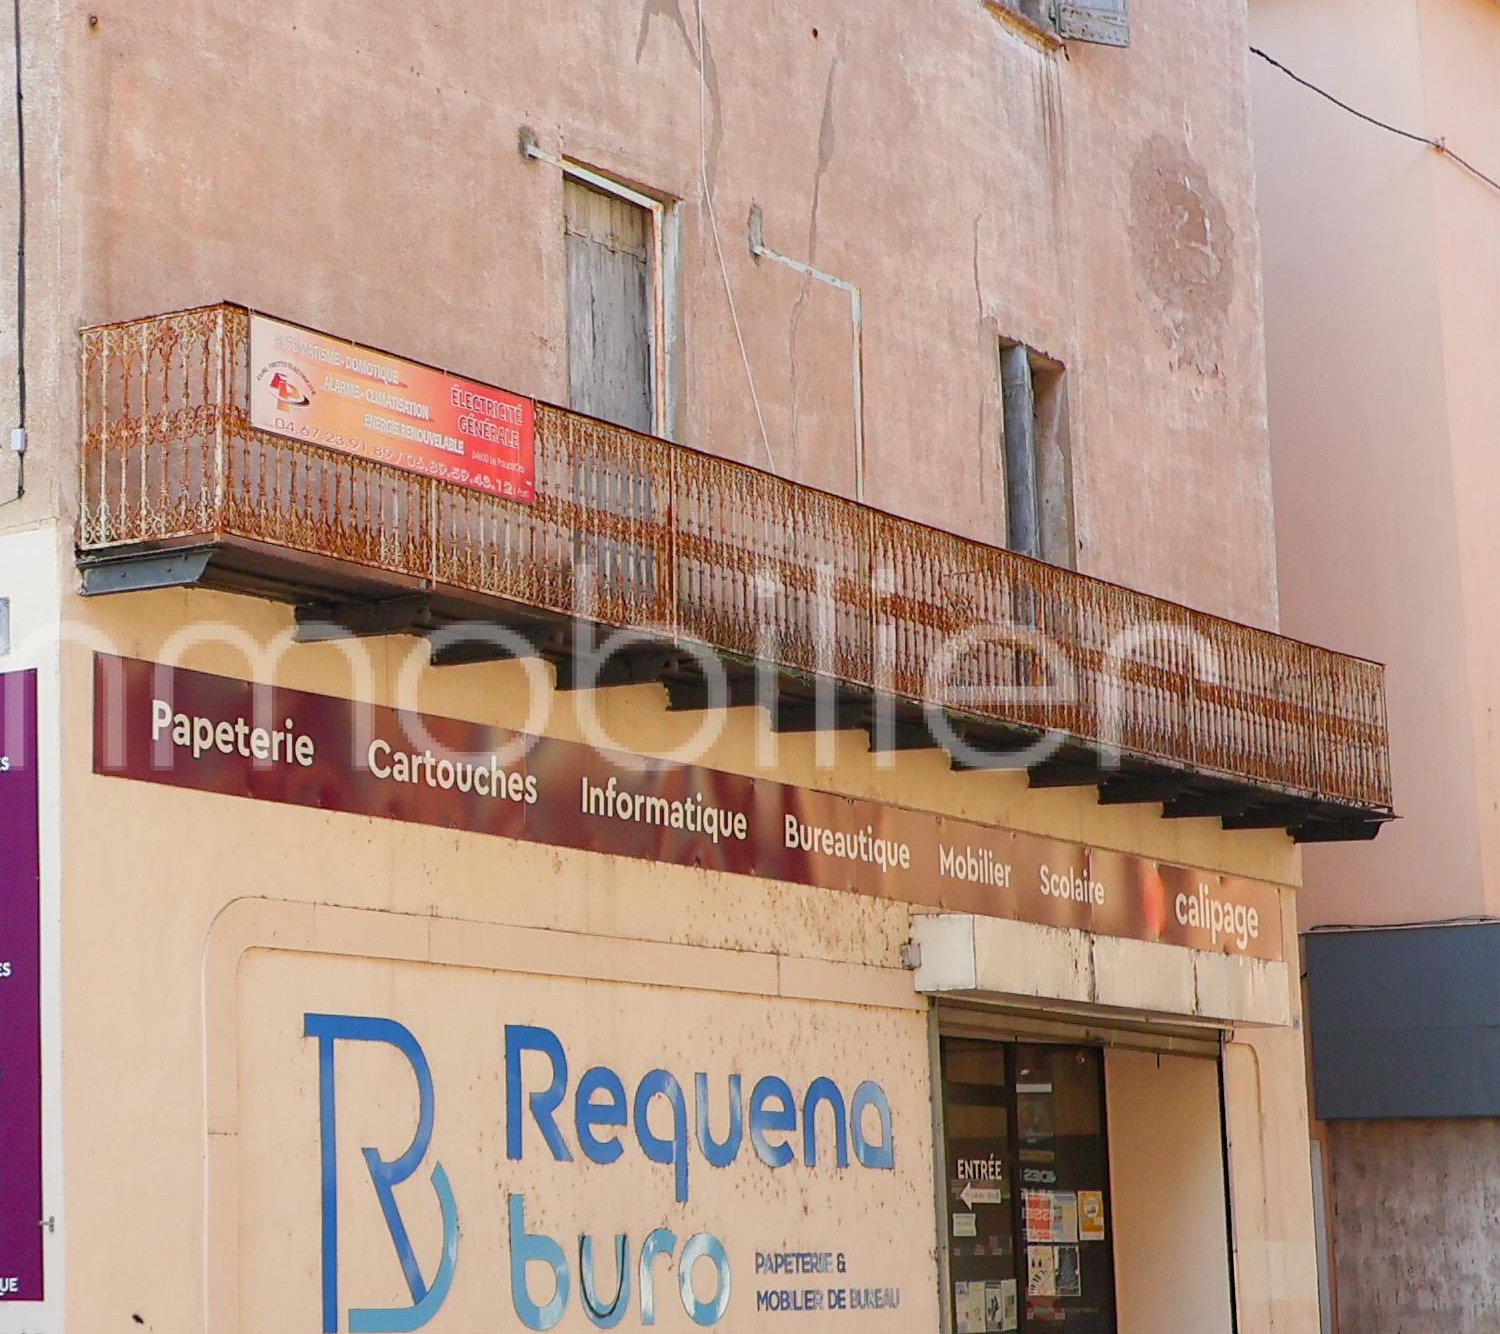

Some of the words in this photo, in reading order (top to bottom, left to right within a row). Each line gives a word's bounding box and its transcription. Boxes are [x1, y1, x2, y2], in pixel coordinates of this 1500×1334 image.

[151, 698, 315, 767] Papeterie
[368, 738, 538, 805] Cartouches
[581, 776, 748, 845] Informatique
[784, 813, 911, 872] Bureautique
[938, 843, 1012, 889] Mobilier
[1039, 864, 1105, 906] Scolaire
[1174, 882, 1260, 951] calipage
[504, 1024, 895, 1203] Requena
[957, 1152, 1003, 1180] ENTRÉE
[508, 1193, 732, 1331] buro
[755, 1251, 833, 1275] PAPETERIE
[756, 1289, 824, 1312] MOBILIER
[827, 1288, 846, 1310] DE
[849, 1287, 900, 1310] BUREAU
